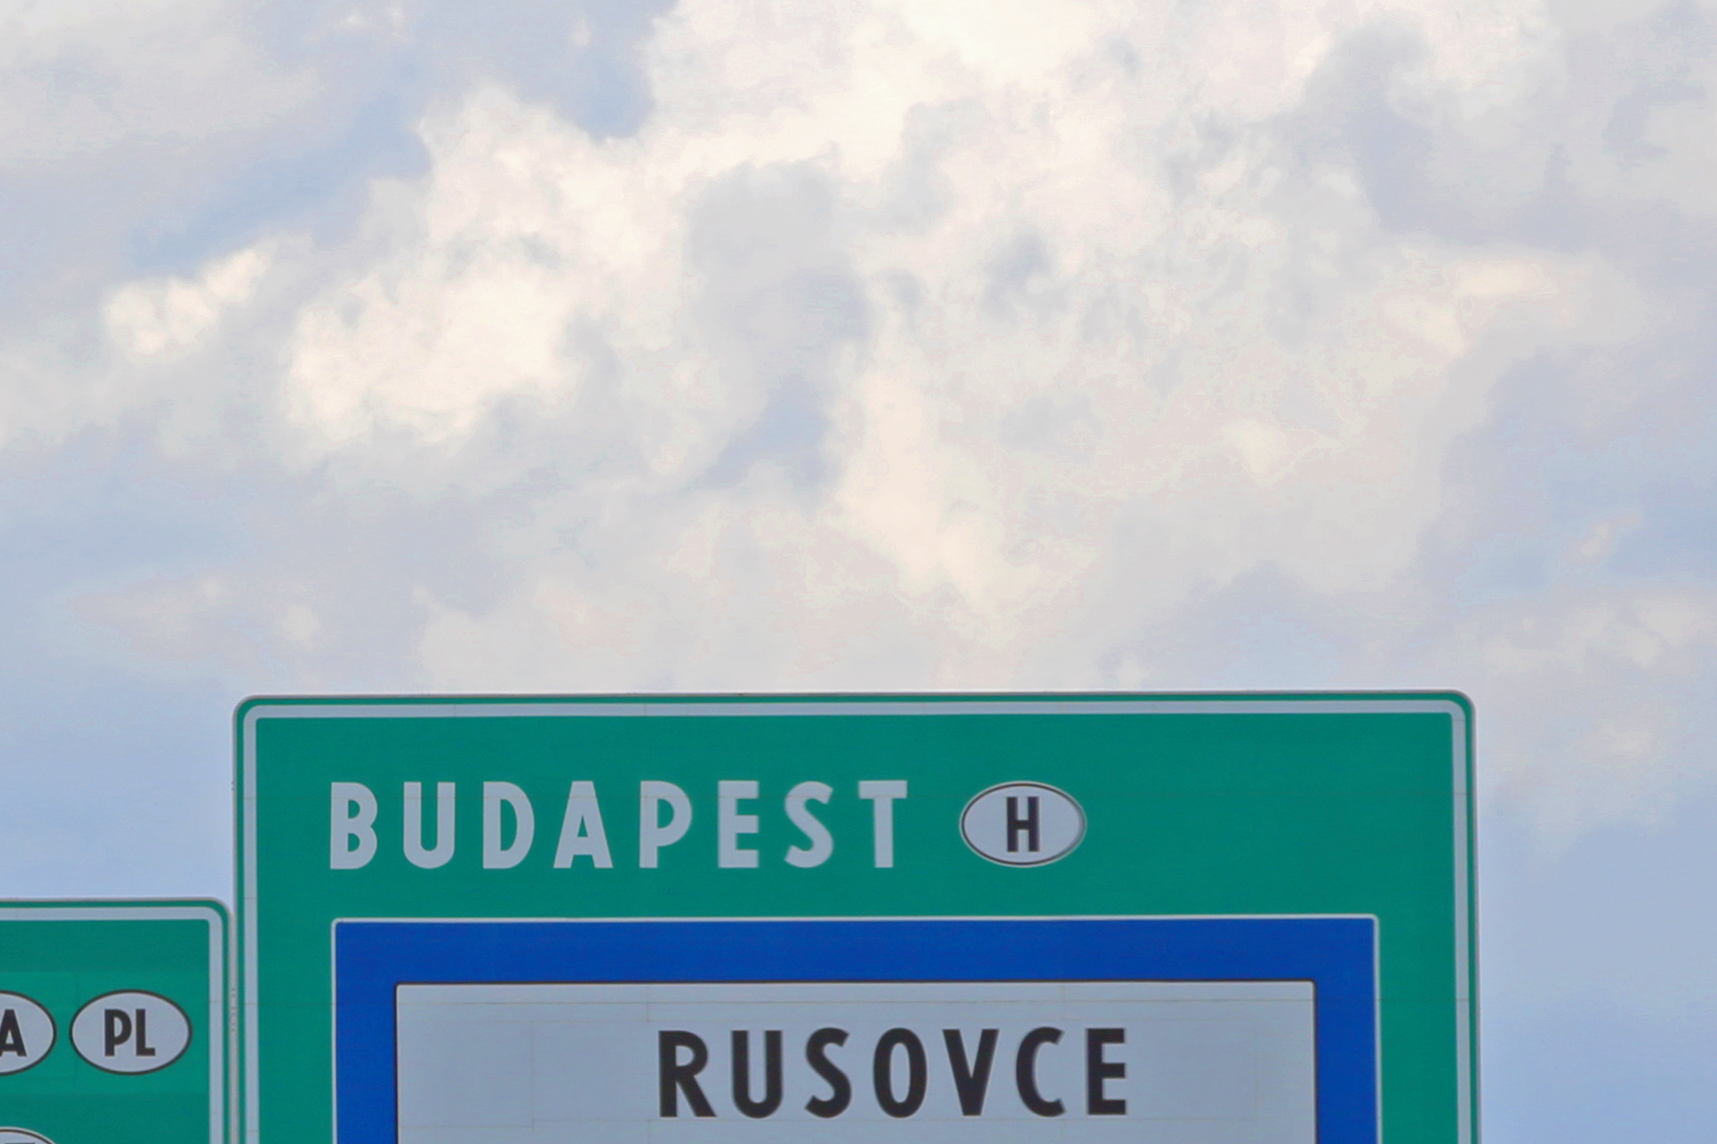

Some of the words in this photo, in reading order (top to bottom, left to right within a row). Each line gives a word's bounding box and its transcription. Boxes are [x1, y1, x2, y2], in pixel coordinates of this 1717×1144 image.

[330, 779, 908, 870] BUDAPEST
[1006, 796, 1040, 853] H
[104, 1008, 156, 1057] PL
[657, 1026, 1128, 1119] RUSOVCE
